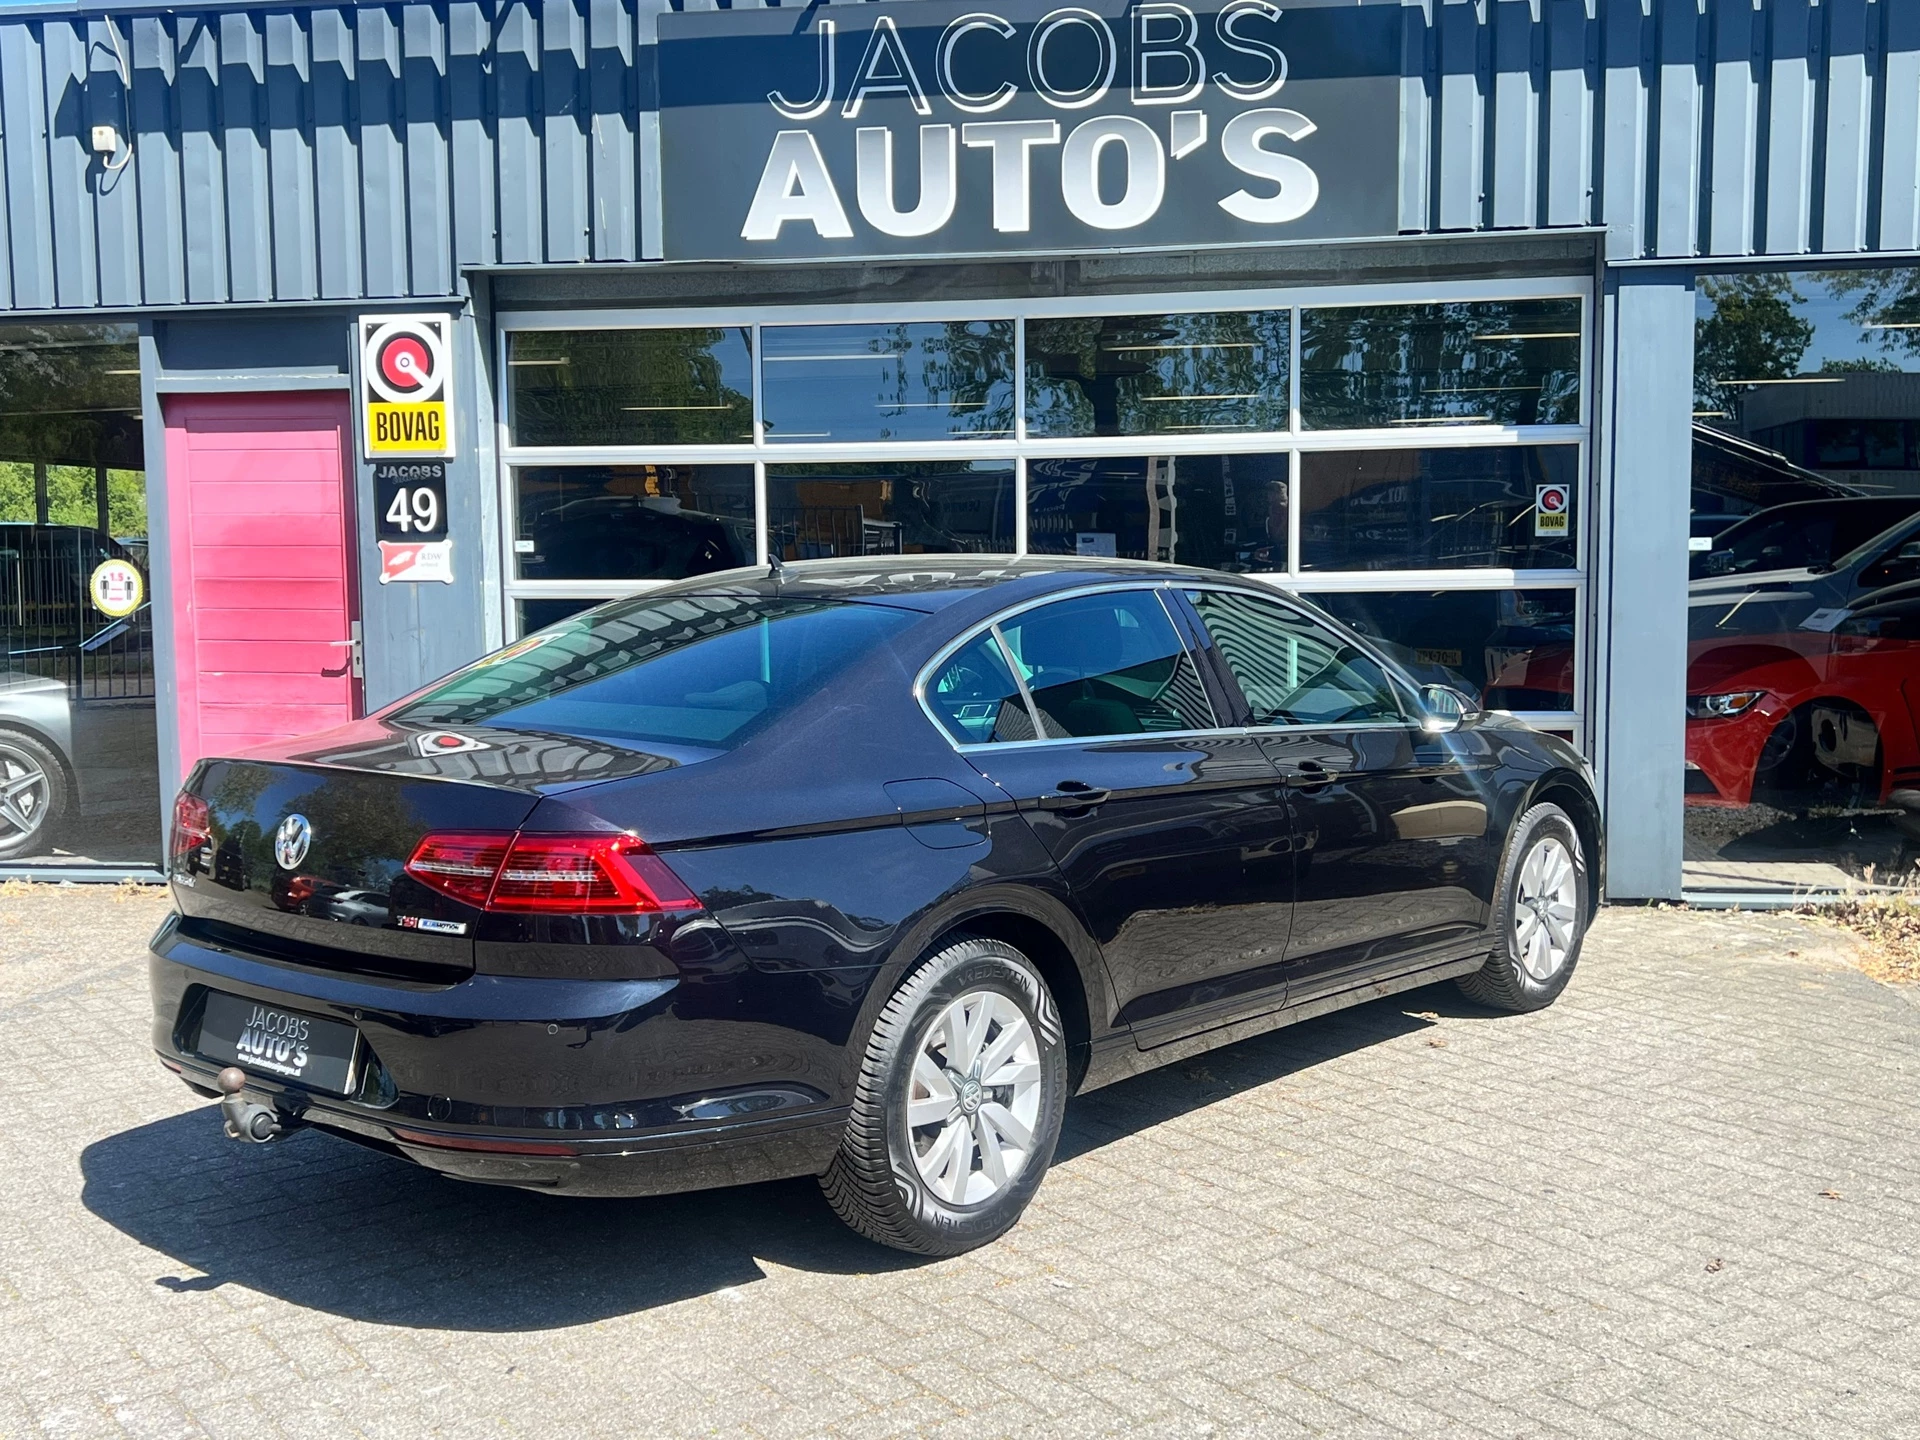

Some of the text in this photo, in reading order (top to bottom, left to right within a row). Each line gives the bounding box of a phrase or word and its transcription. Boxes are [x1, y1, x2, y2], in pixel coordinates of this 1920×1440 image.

[766, 1, 1289, 119] JACOBS
[740, 107, 1320, 240] AUTO'S
[376, 411, 440, 442] BOVAG
[378, 465, 442, 479] JACOBS
[386, 487, 438, 532] 49
[1540, 516, 1564, 527] BOVAG
[421, 552, 443, 560] RDW
[246, 1006, 309, 1041] JACOBS
[236, 1027, 309, 1068] AUTO'S
